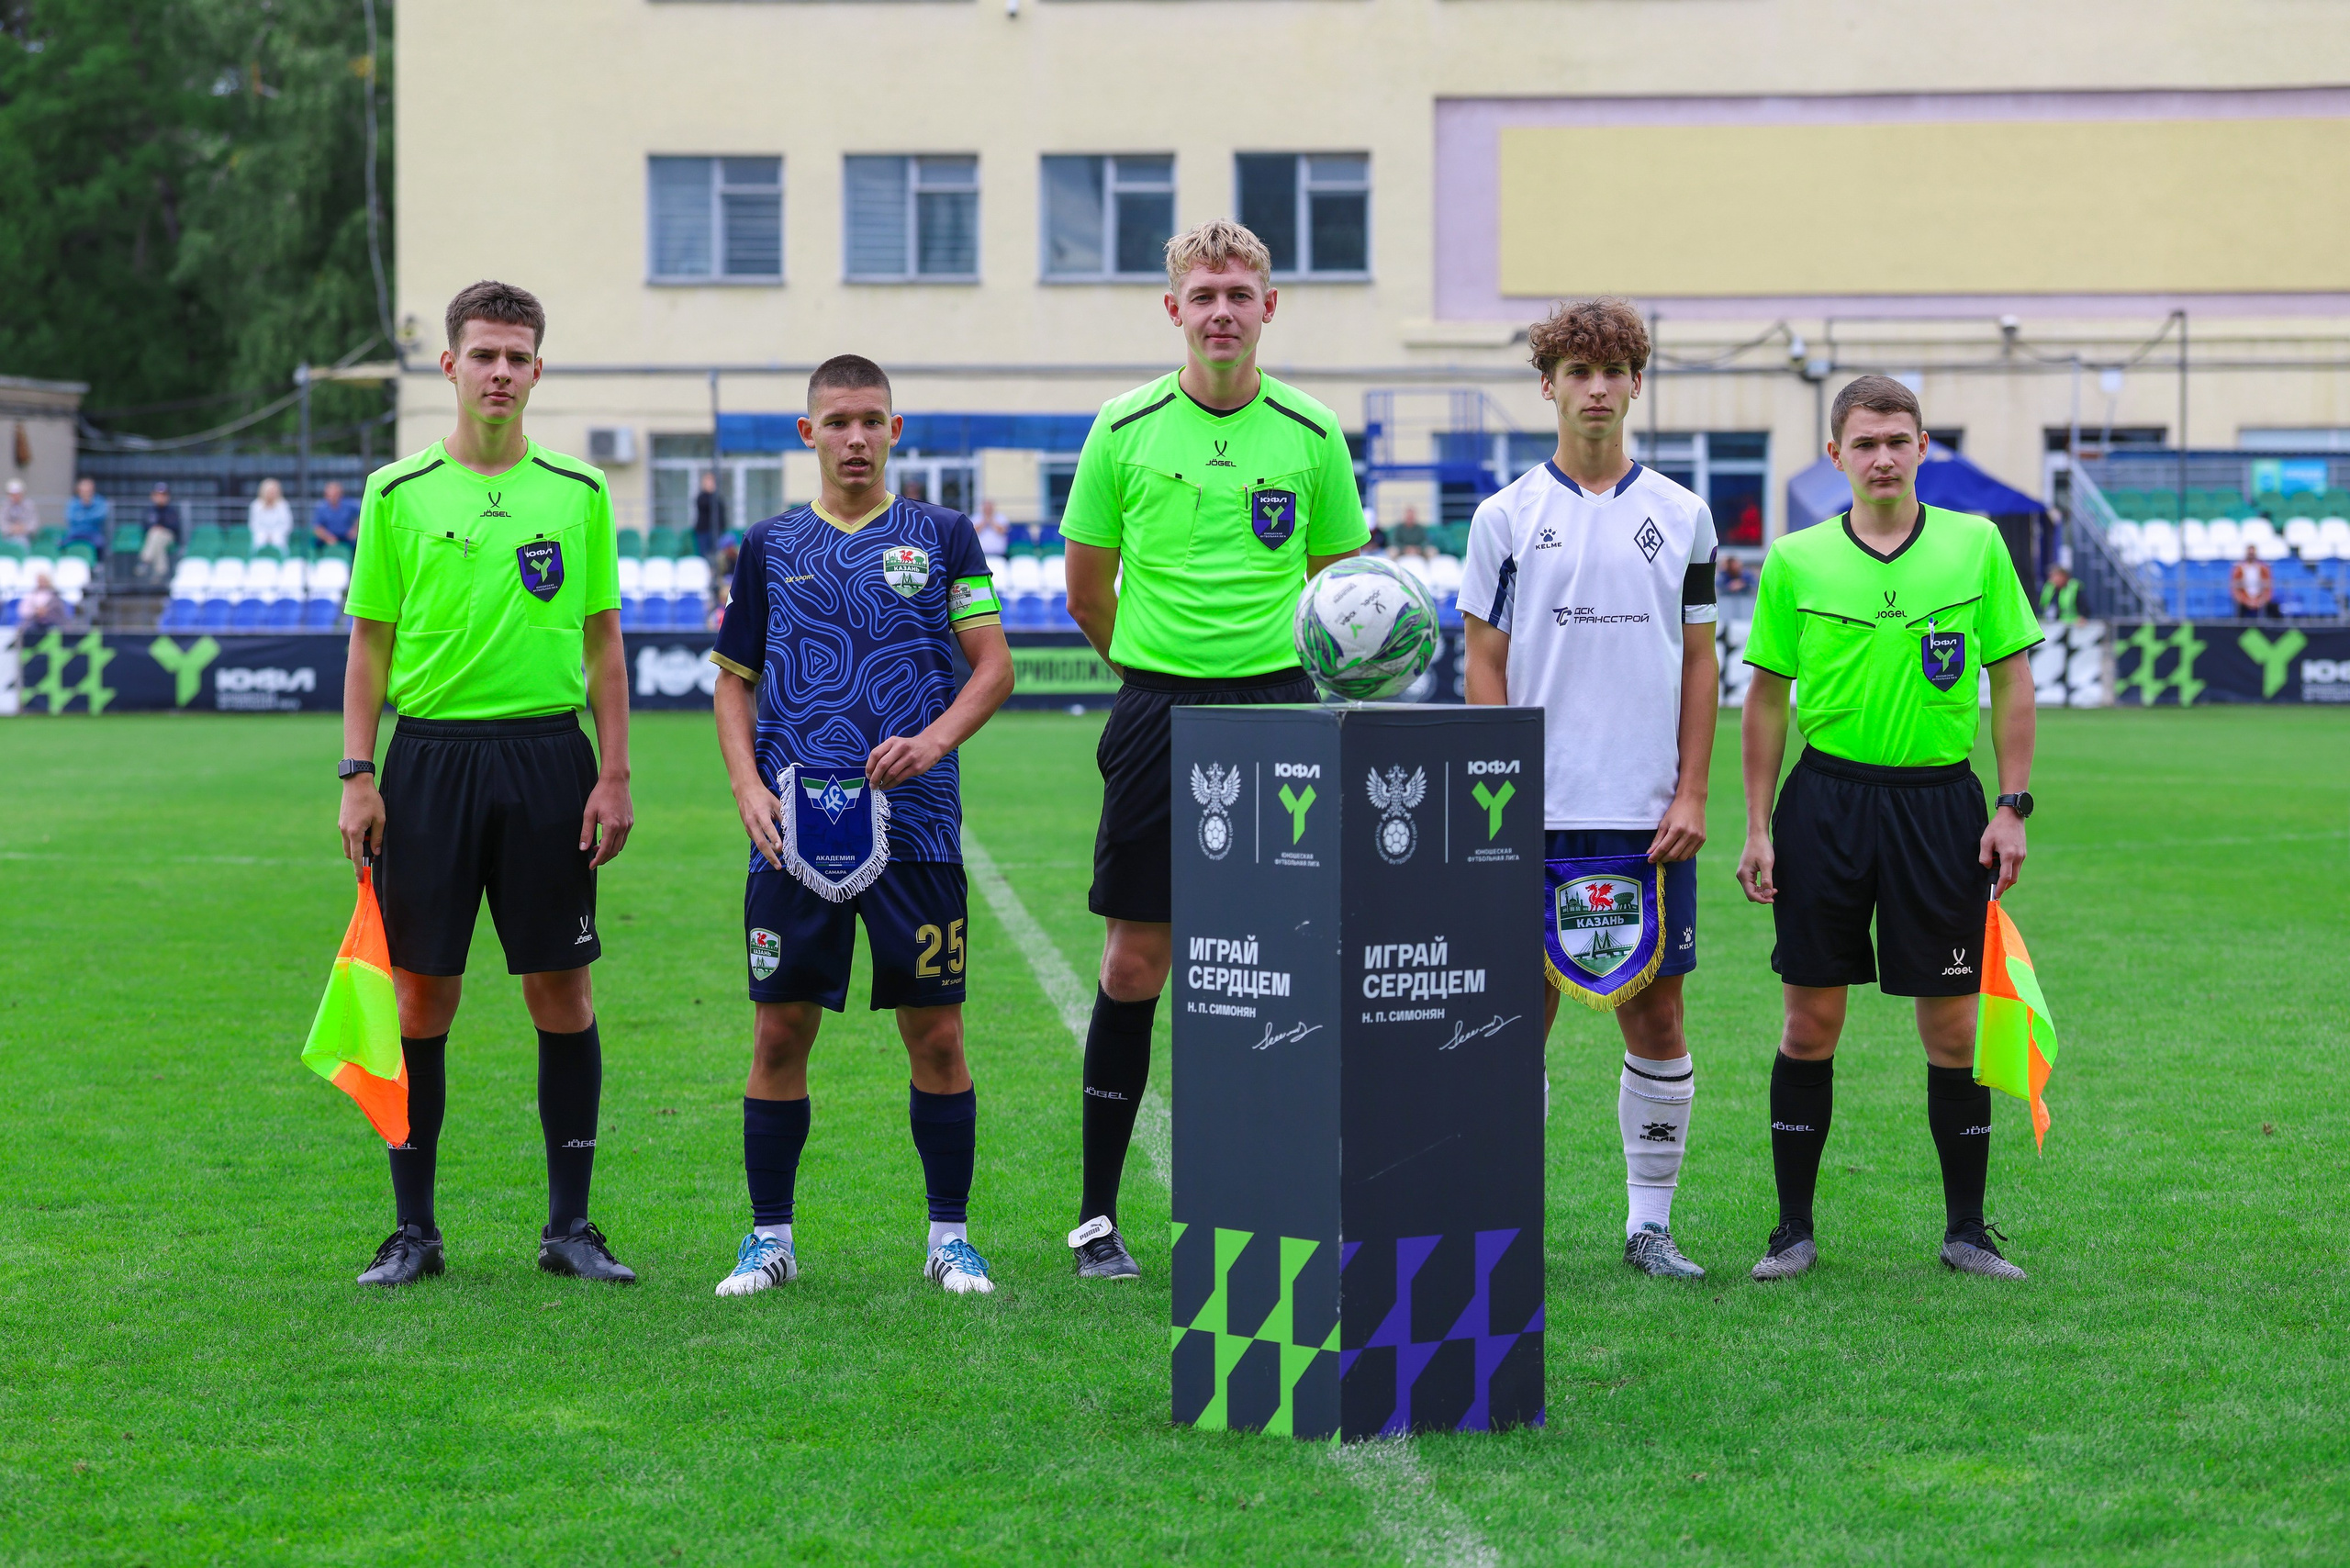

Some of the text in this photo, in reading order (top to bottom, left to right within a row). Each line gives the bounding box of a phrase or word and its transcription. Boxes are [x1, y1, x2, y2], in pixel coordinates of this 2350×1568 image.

[479, 510, 511, 518] JÖGEL
[1535, 542, 1562, 550] KELME
[1573, 607, 1595, 615] ДСК
[1573, 612, 1650, 624] ТРАНССТРОЙ
[1275, 762, 1320, 778] ЮФЛ
[1468, 759, 1520, 775] ЮФЛ
[1576, 915, 1625, 928] КАЗАНЬ
[916, 918, 965, 979] 25
[1189, 934, 1259, 966] ИГРАЙ
[1363, 935, 1449, 970] ИГРАЙ
[1188, 965, 1291, 1000] СЕРДЦЕМ
[1362, 969, 1486, 1002] СЕРДЦЕМ
[1187, 1001, 1257, 1019] Н. П. СИМОНЯН
[1361, 1008, 1446, 1024] Н. П. СИМОНЯН
[1083, 1086, 1129, 1101] JÖGEL
